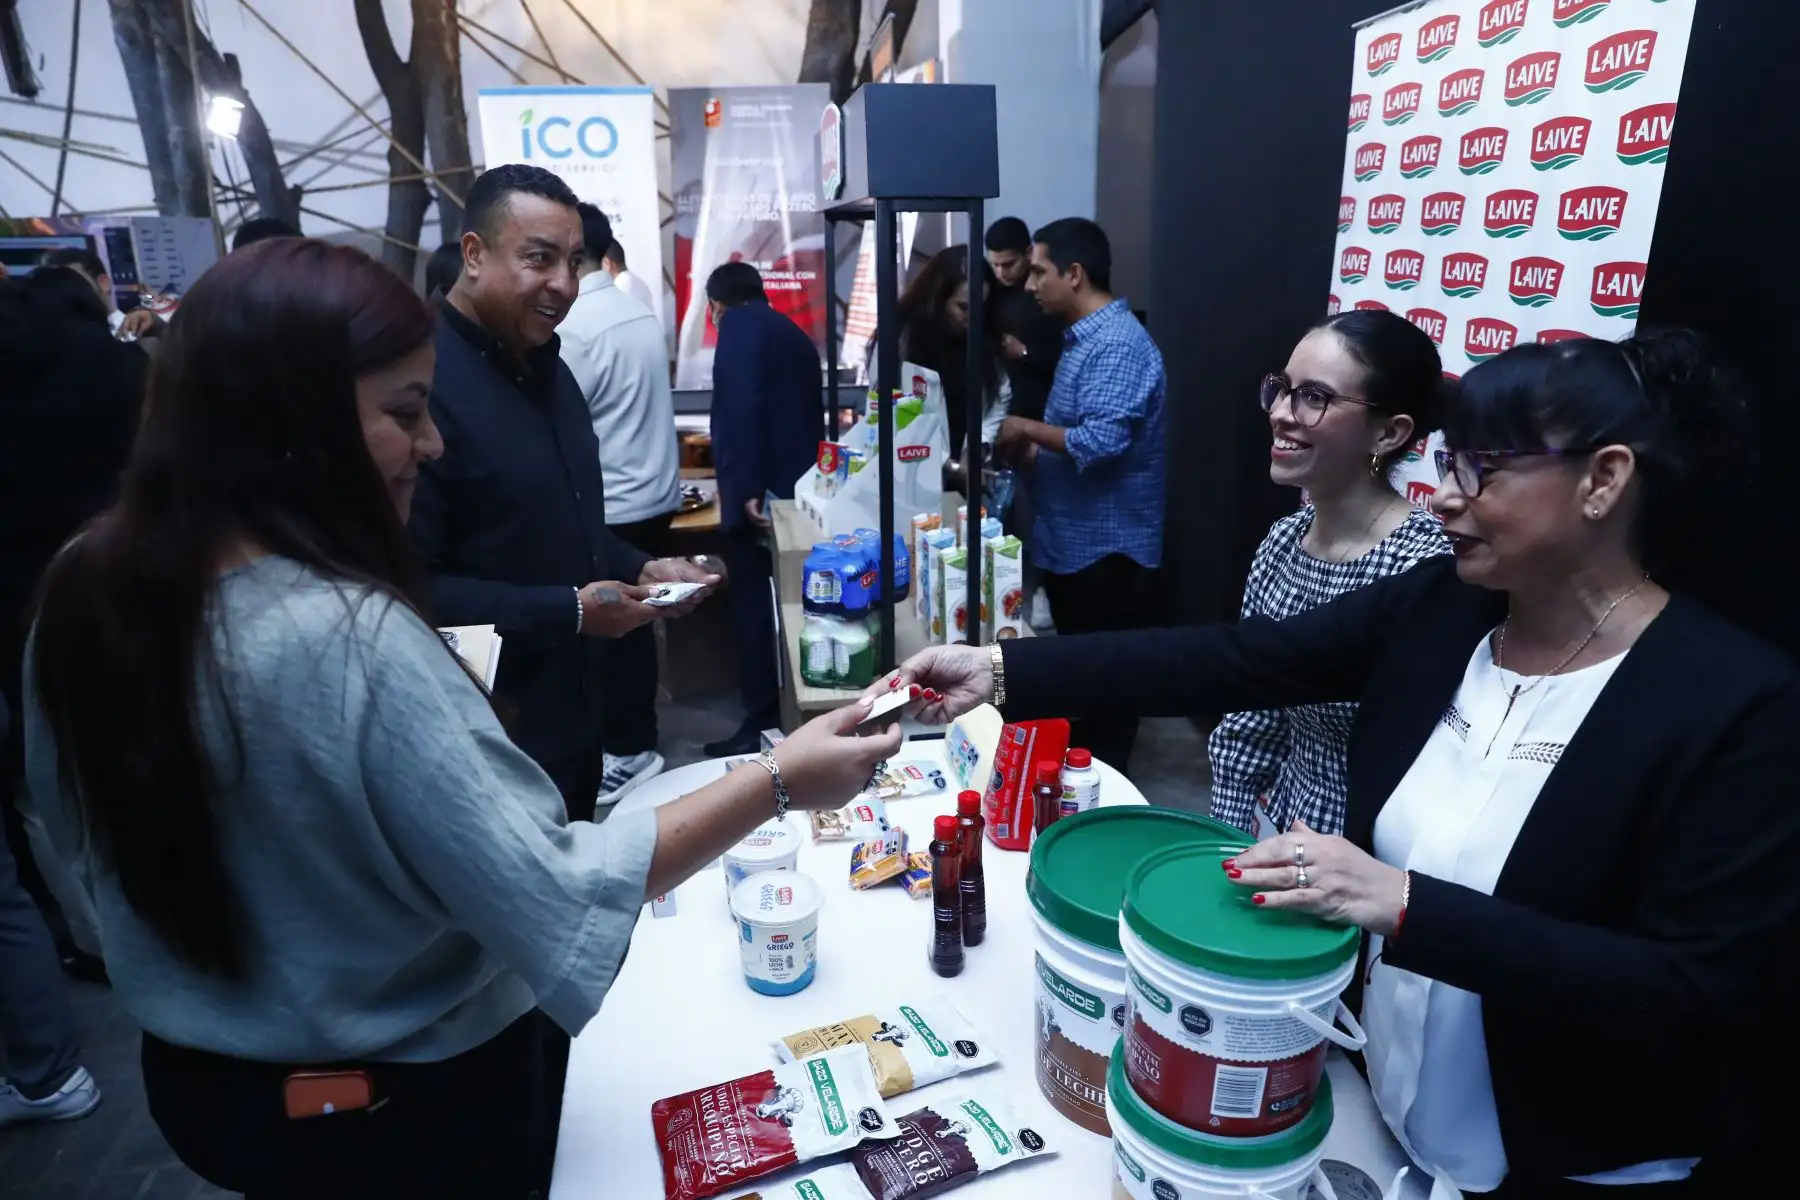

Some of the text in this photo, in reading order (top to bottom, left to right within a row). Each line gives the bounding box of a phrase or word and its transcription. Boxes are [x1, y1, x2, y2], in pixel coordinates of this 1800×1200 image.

[1482, 0, 1524, 31] LAIVE
[1420, 21, 1456, 48] LAIVE
[1370, 39, 1398, 63] LAIVE
[1591, 39, 1650, 73] LAIVE
[1509, 60, 1556, 89] LAIVE
[1386, 89, 1418, 112] LAIVE
[1442, 76, 1480, 101] LAIVE
[1350, 100, 1369, 118] AIVE
[1536, 126, 1585, 151] LAIVE
[1623, 116, 1674, 144] LAIV
[1357, 149, 1382, 168] LAIVE
[1404, 143, 1438, 164] LAIVE
[1463, 135, 1503, 158] LAIVE
[1370, 202, 1402, 220] LAIVE
[1424, 201, 1461, 220] LAIVE
[1488, 199, 1533, 220] LAIVE
[1563, 197, 1620, 220] LAIVE
[1342, 253, 1368, 271] LAIVE
[1388, 257, 1421, 276] LAIVE
[1445, 260, 1485, 283] LAIVE
[1513, 265, 1557, 290] LAIVE
[1597, 271, 1645, 298] LAIV
[1469, 325, 1512, 350] LAIVE
[900, 448, 929, 458] LAIVE
[1410, 487, 1433, 513] LAI
[767, 942, 794, 950] GRIEGO
[1041, 966, 1095, 1013] VELARDE
[813, 1061, 843, 1130] BAZO VELARDE
[1056, 1068, 1105, 1105] LECHE
[716, 1086, 730, 1113] UDGE
[722, 1114, 748, 1172] ESPECIAL
